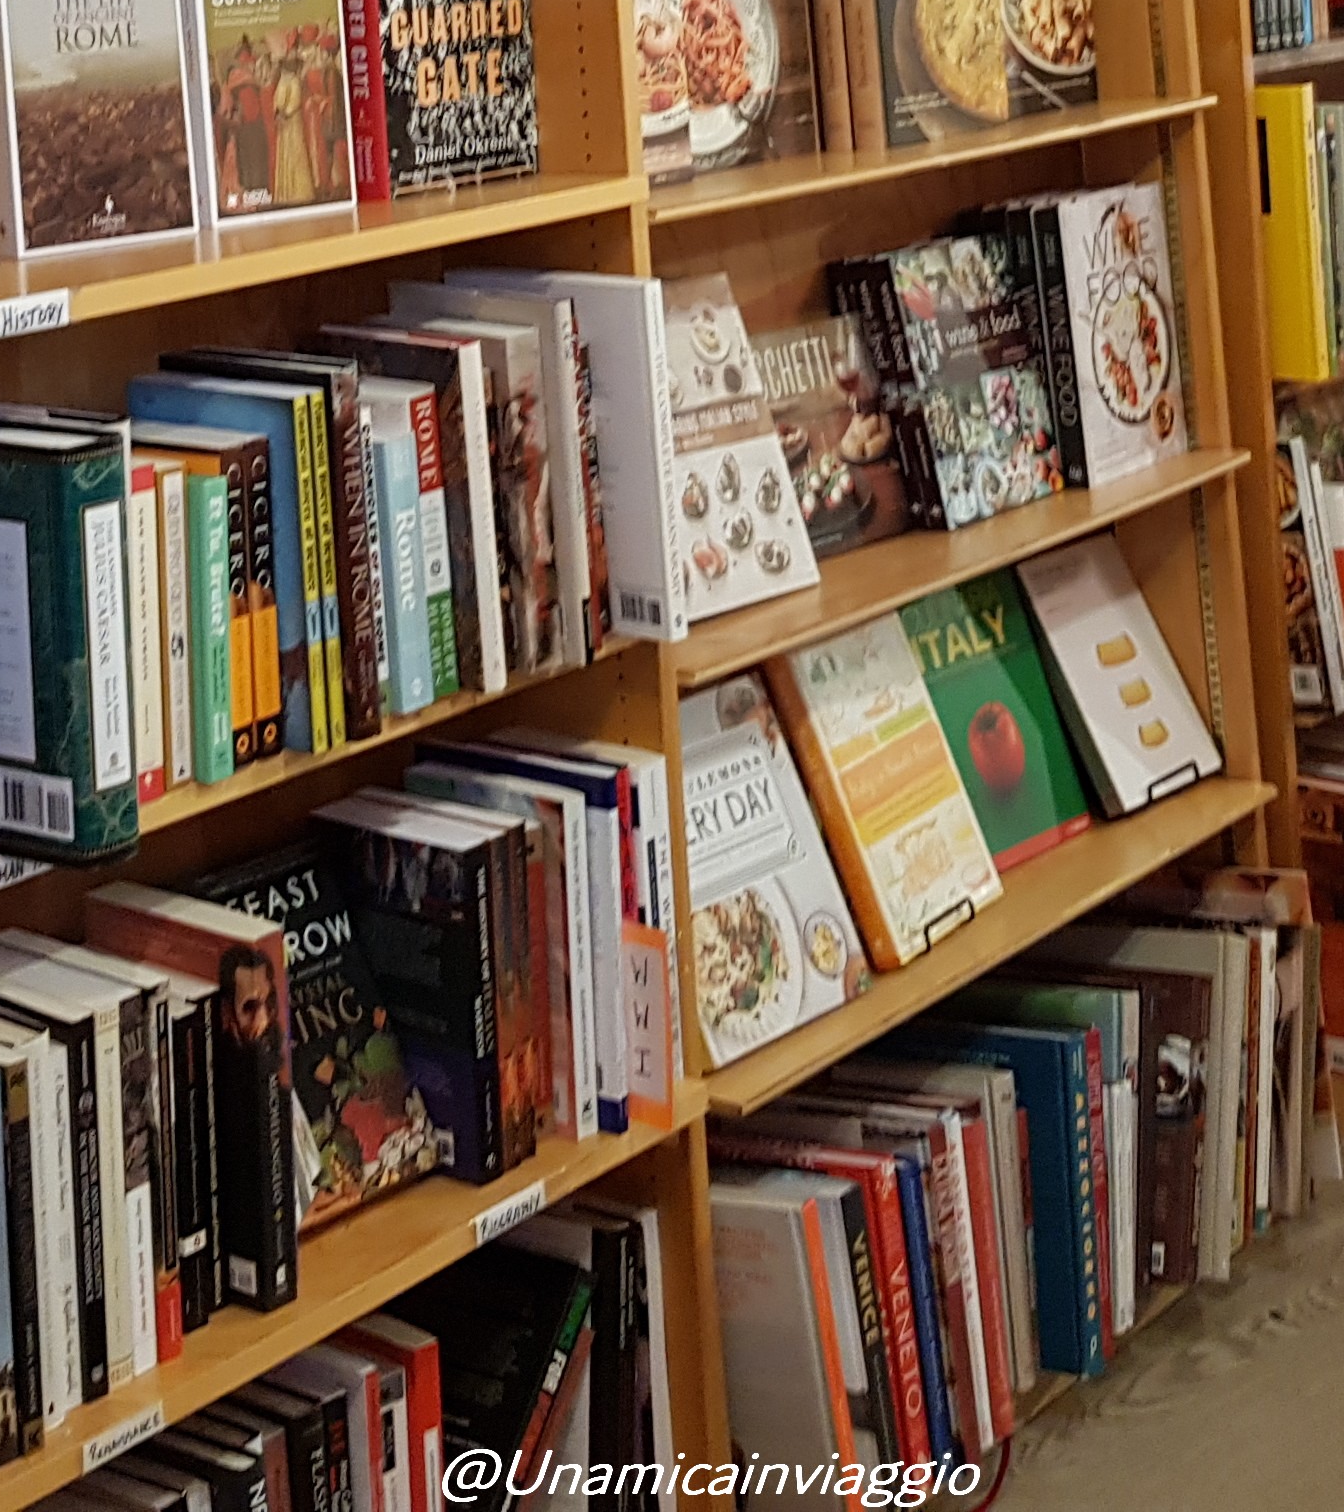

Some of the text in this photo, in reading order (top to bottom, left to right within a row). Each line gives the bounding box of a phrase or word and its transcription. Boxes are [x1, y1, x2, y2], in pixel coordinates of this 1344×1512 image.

[56, 22, 139, 53] ROME
[72, 6, 134, 24] ANCIENT
[350, 47, 369, 99] GATE
[416, 49, 503, 108] GATE
[415, 136, 513, 165] Daniel Okrent
[2, 301, 65, 336] HISTORY
[992, 312, 1022, 339] food
[415, 397, 438, 487] ROME
[227, 462, 244, 599] CICERO
[251, 454, 272, 590] CICERO
[343, 421, 373, 646] WHEN IN ROME
[396, 511, 418, 612] Rome
[91, 520, 113, 666] JULIUS CAESAR
[725, 778, 774, 827] DAY
[629, 954, 652, 1079] WWI
[852, 1230, 880, 1347] VENICE
[889, 1259, 923, 1419] VENETO
